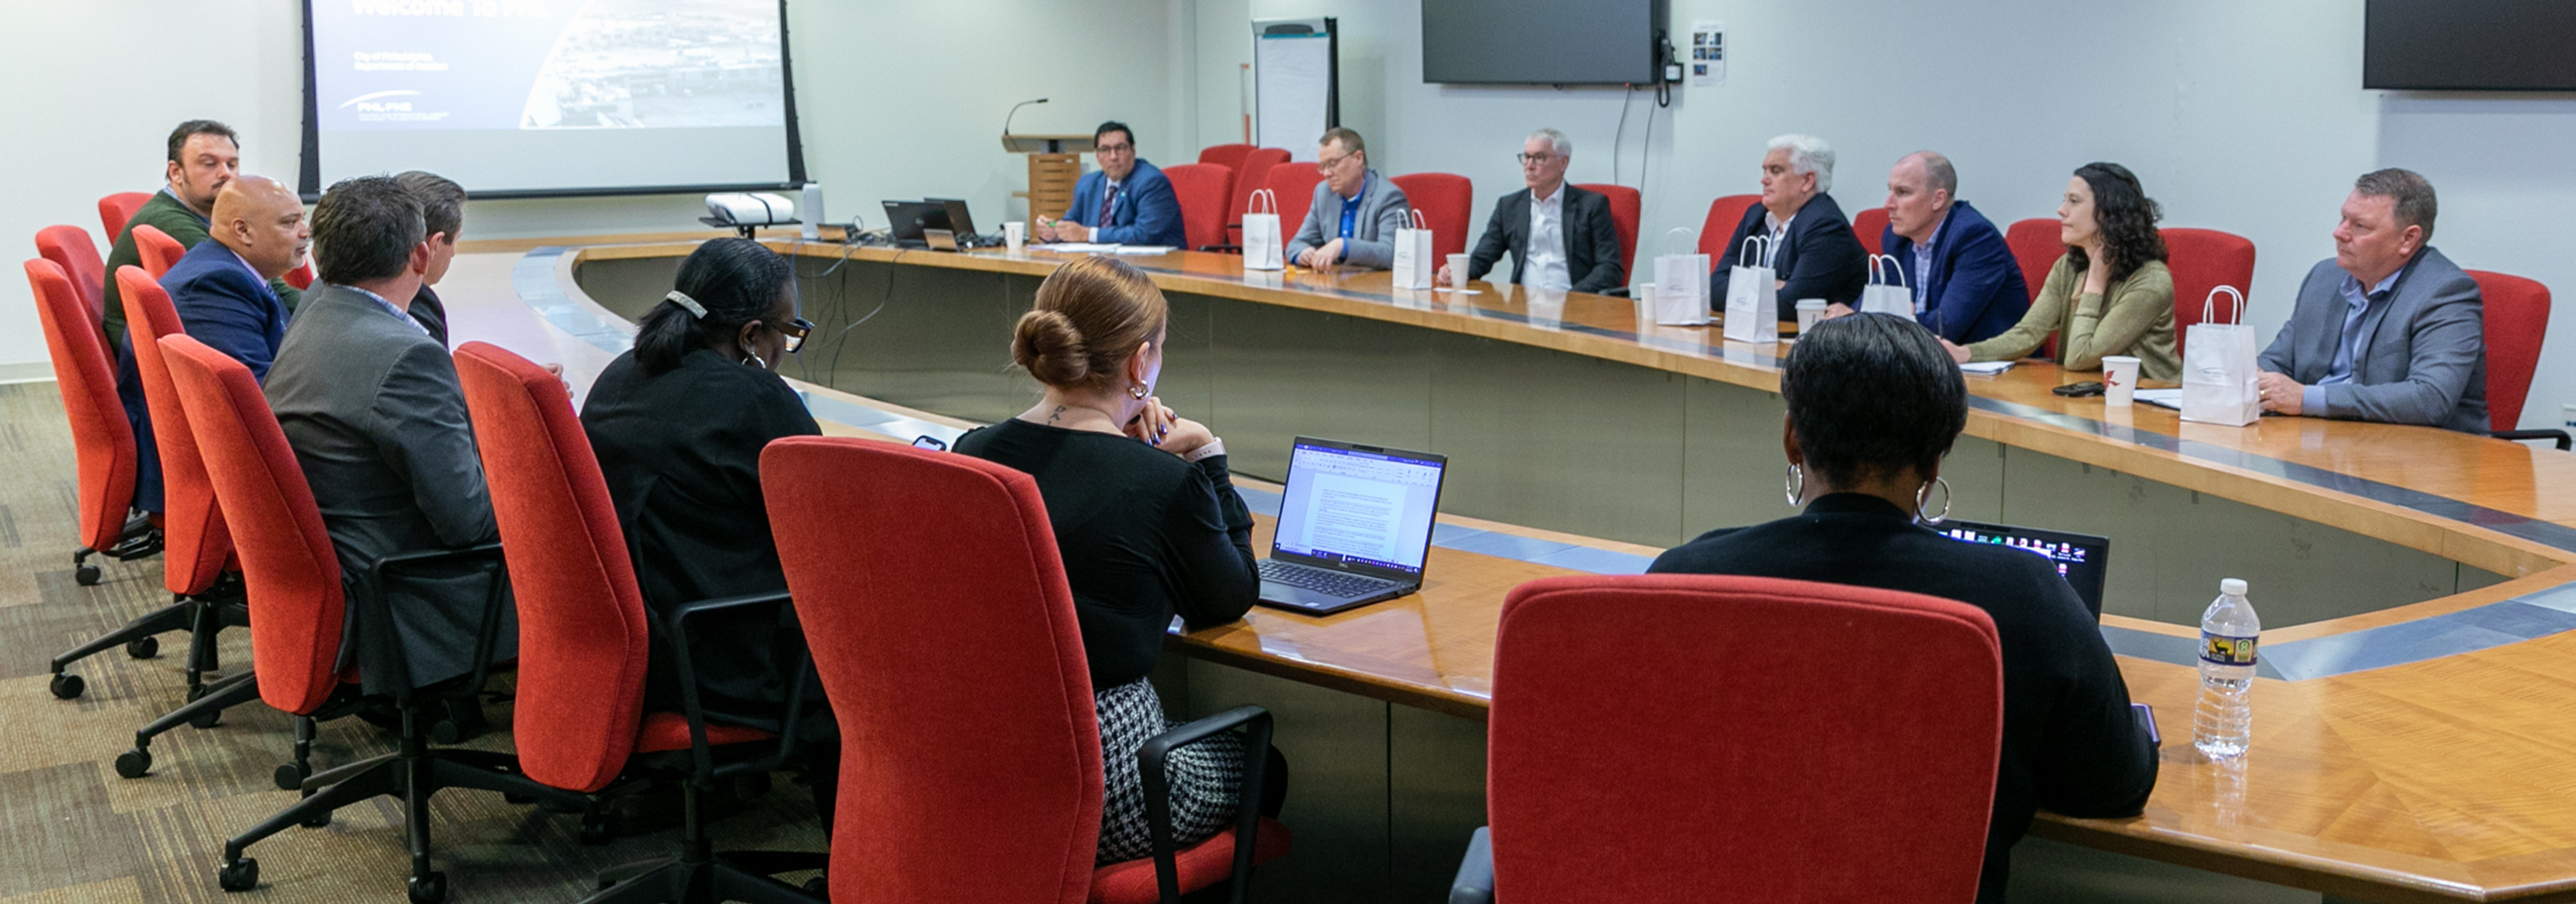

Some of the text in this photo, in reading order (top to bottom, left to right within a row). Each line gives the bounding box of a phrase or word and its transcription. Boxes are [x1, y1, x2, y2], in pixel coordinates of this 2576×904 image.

[351, 0, 464, 17] Welcome
[354, 52, 370, 62] City
[371, 52, 381, 60] of
